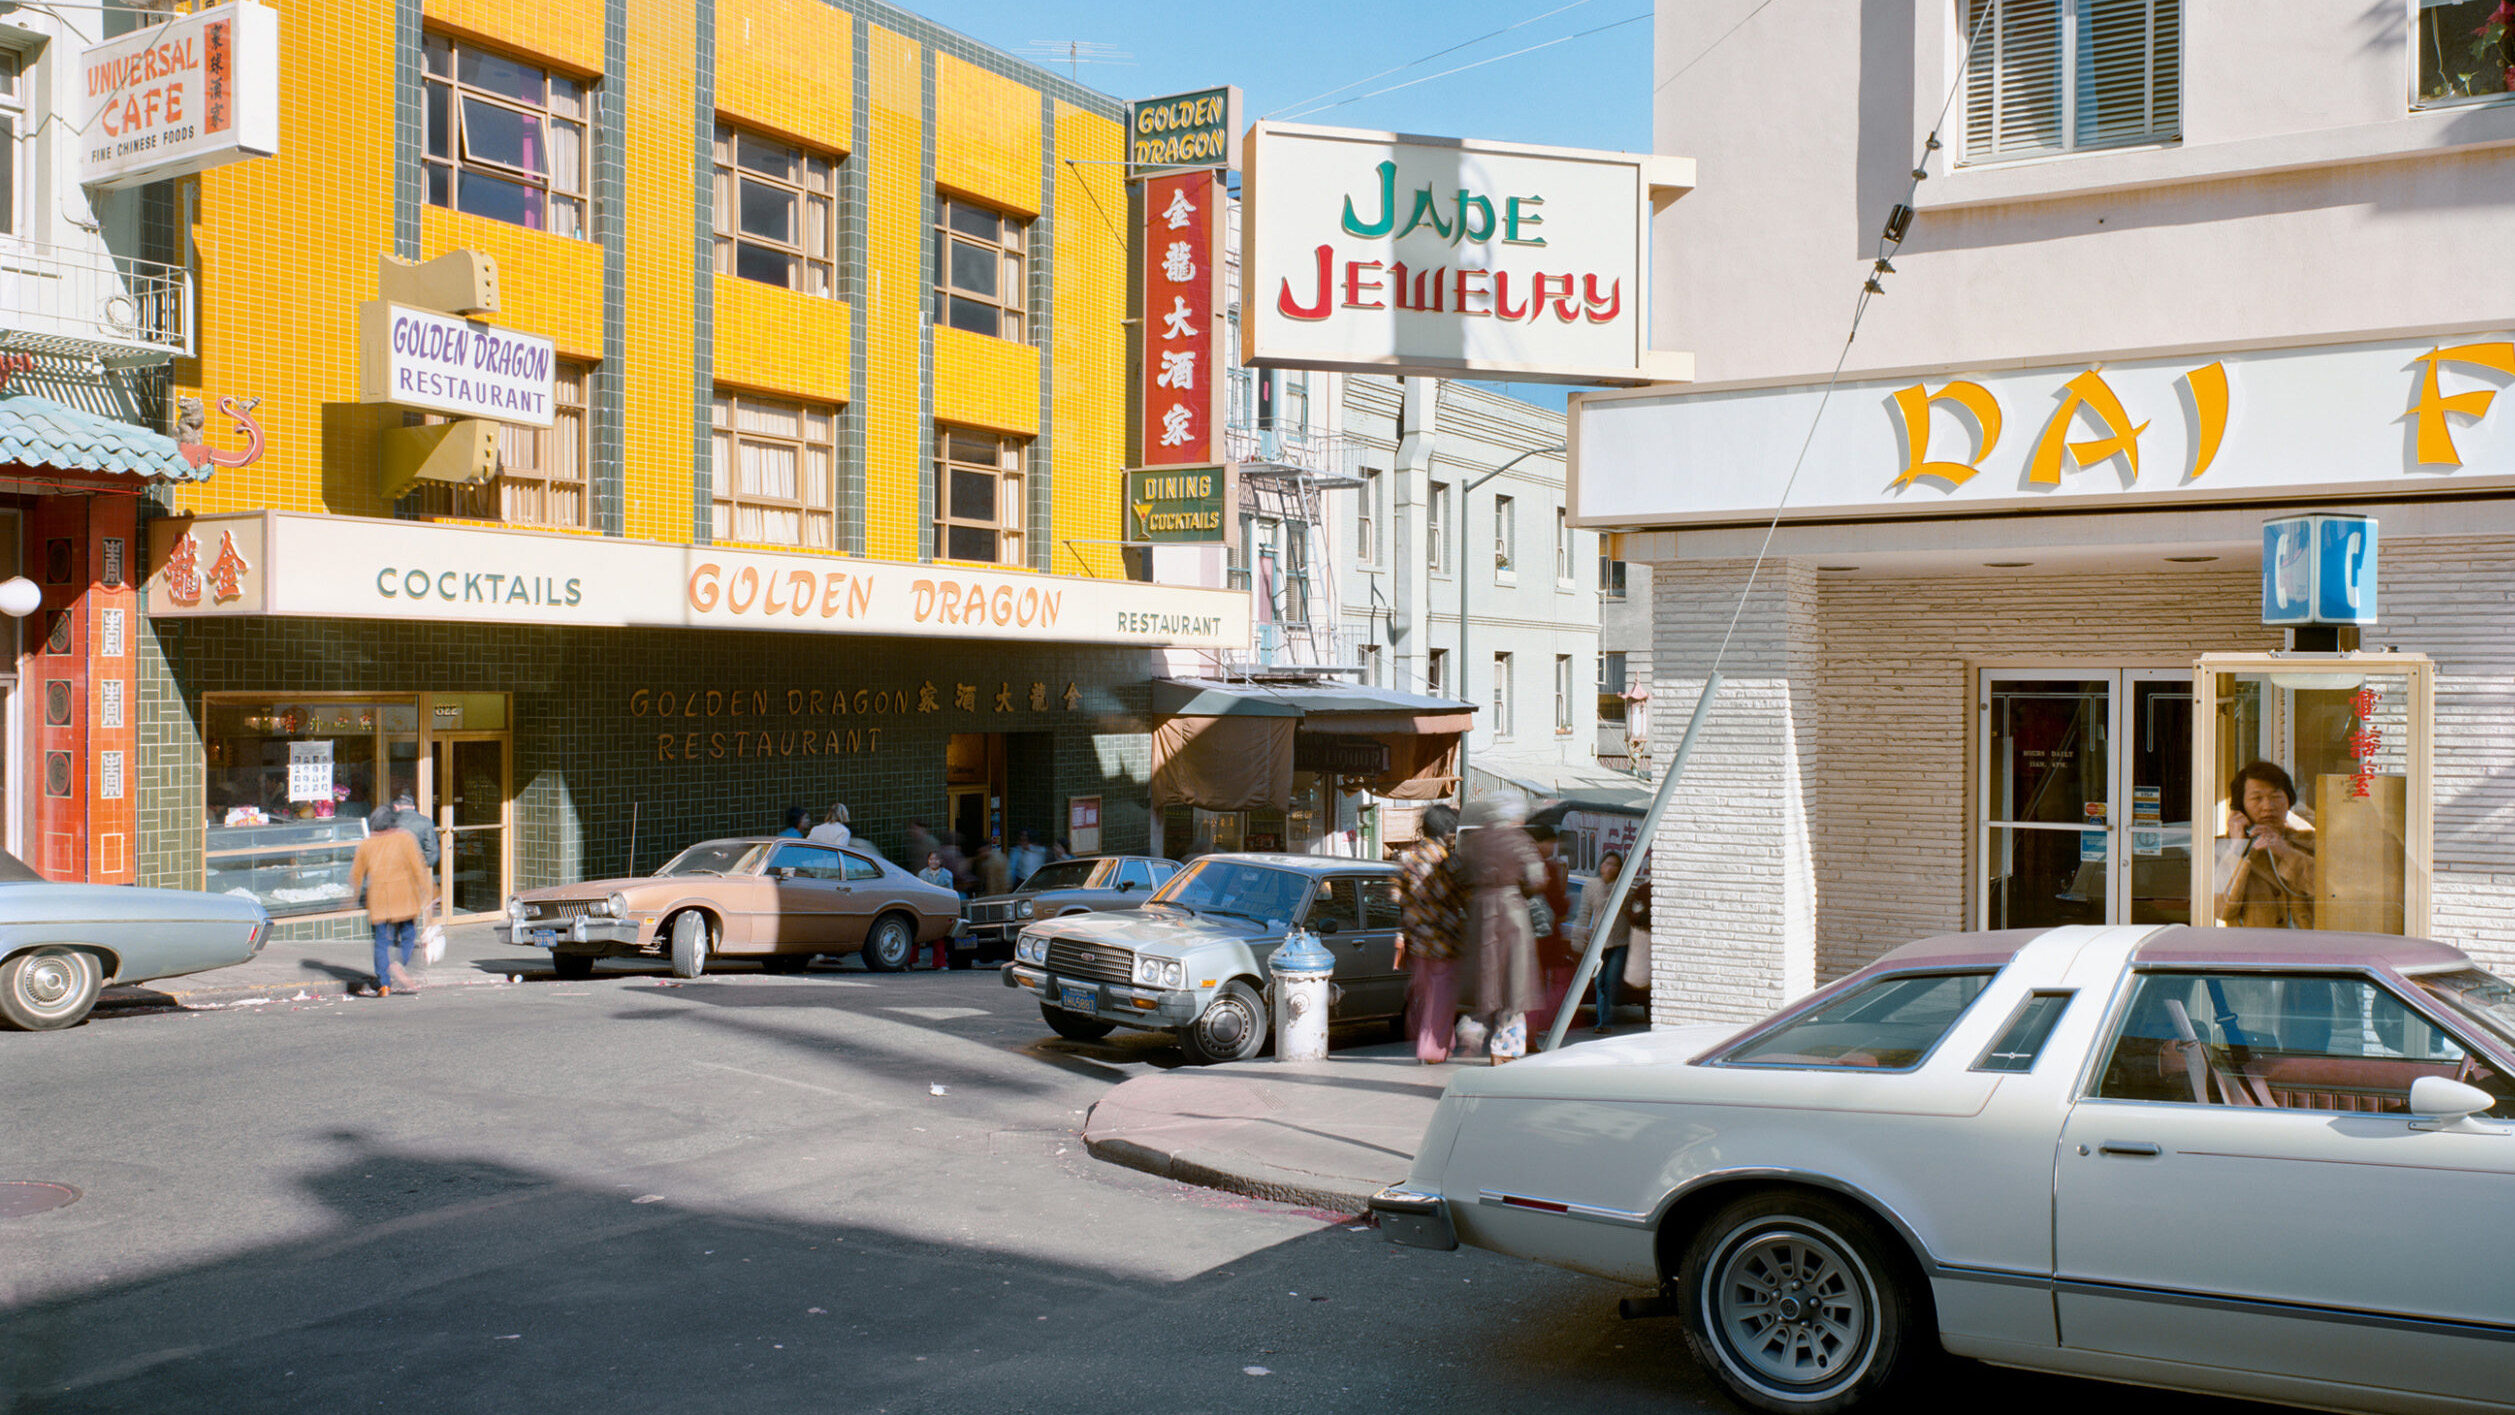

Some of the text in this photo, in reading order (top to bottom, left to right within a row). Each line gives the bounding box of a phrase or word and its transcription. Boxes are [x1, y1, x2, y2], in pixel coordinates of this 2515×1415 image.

[88, 37, 199, 97] UNIVERSAL
[102, 82, 183, 137] CAFE
[1137, 95, 1224, 134] GOLDEN
[92, 125, 194, 163] FINE CHINESE FOODS
[1134, 128, 1226, 166] DRAGON
[1342, 159, 1548, 248] JADE
[1278, 244, 1621, 325] JEWELRY
[1157, 187, 1198, 446] 金龍大酒家
[394, 316, 550, 383] GOLDEN DRAGON
[400, 367, 546, 414] RESTAURANT
[1891, 360, 2229, 490] DAI
[1145, 474, 1212, 500] DINING
[1149, 510, 1220, 532] COCKTAILS
[376, 567, 583, 607] COCKTAILS
[688, 563, 1062, 629] GOLDEN DRAGON
[1117, 611, 1222, 637] RESTAURANT
[630, 688, 909, 717] GOLDEN DRAGON
[657, 728, 881, 761] RESTAURANT
[2051, 750, 2074, 758] DAILY
[2348, 688, 2382, 798] 電話室
